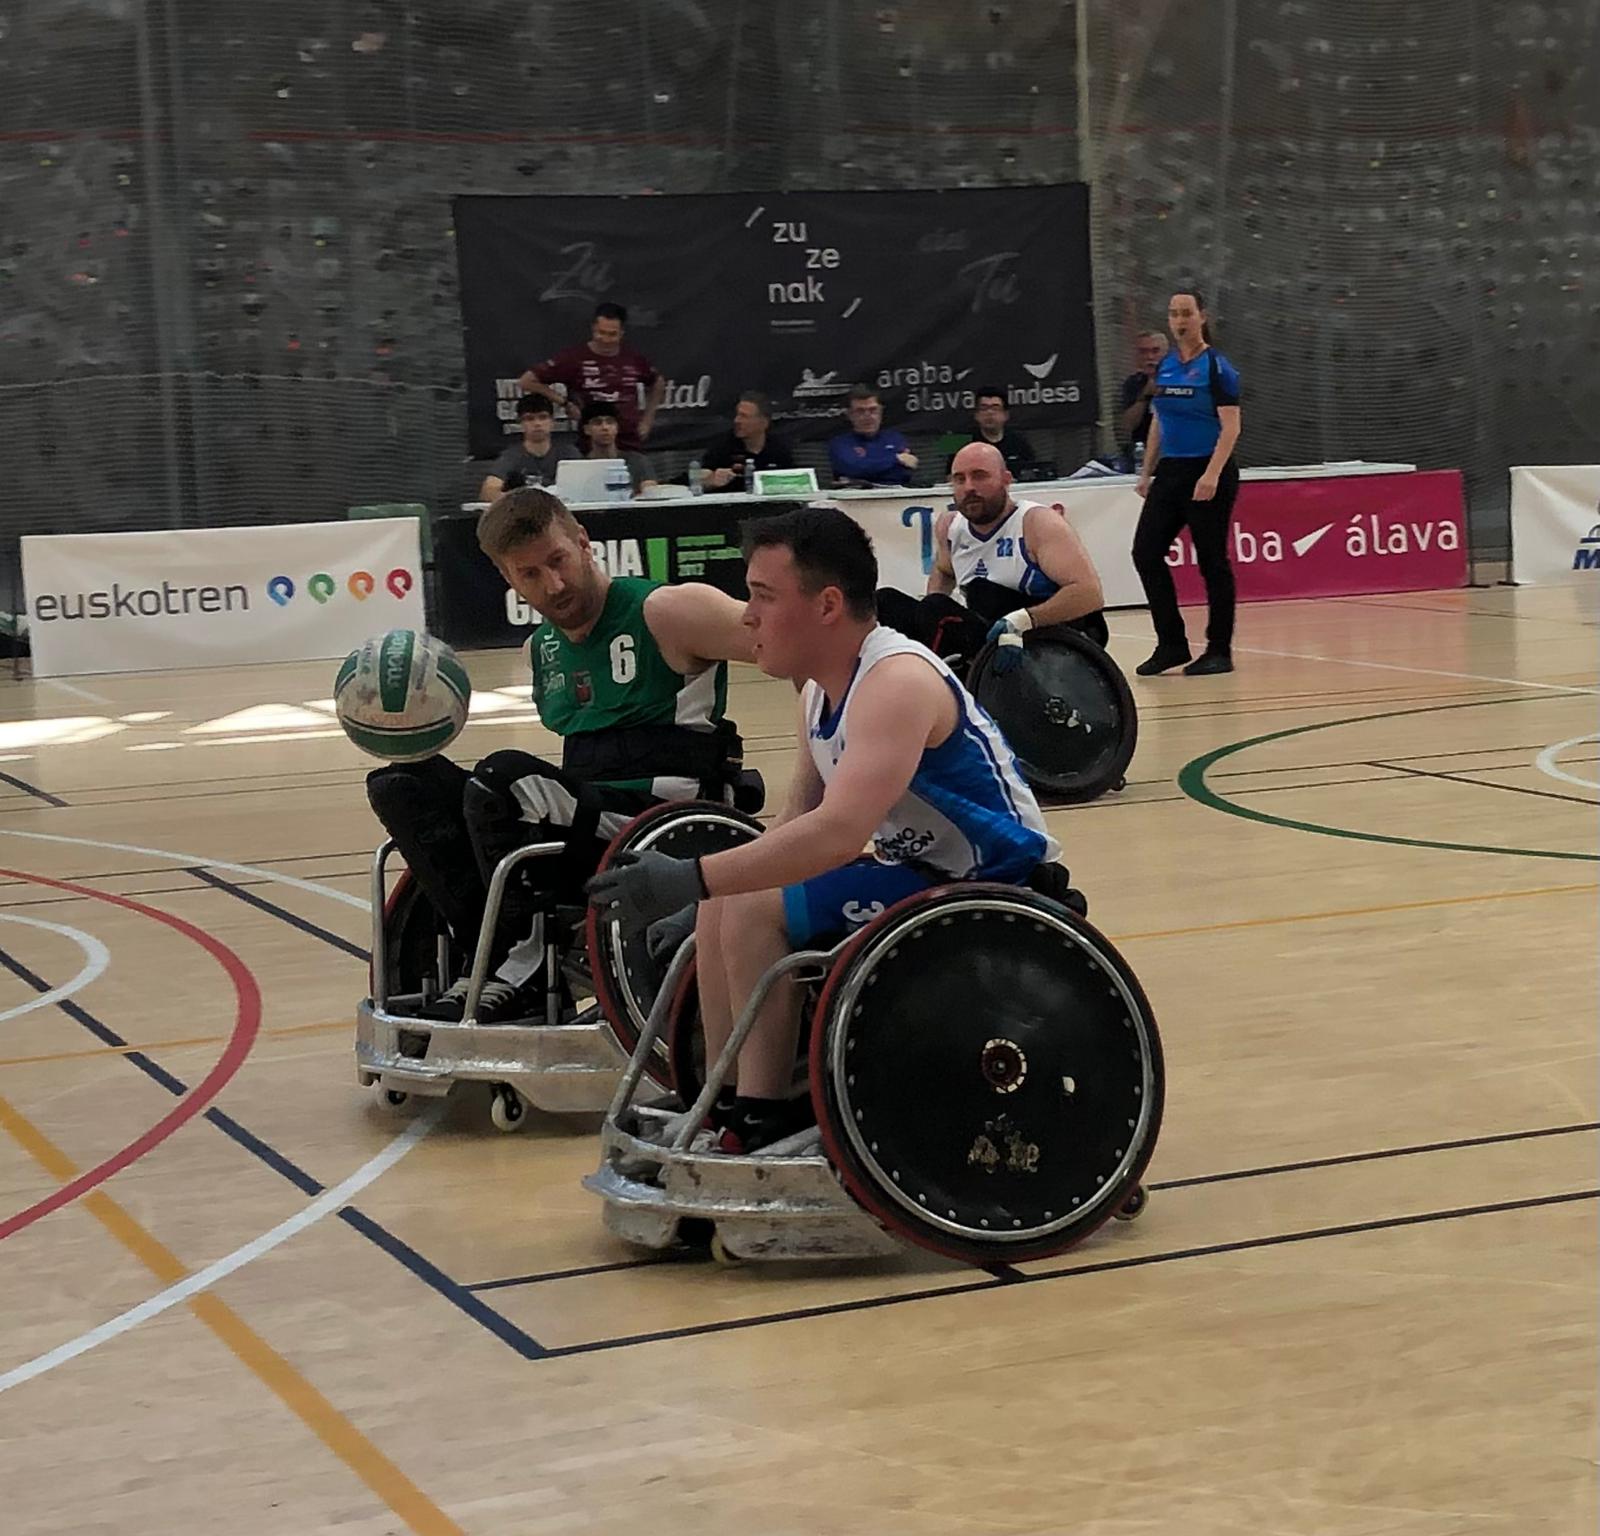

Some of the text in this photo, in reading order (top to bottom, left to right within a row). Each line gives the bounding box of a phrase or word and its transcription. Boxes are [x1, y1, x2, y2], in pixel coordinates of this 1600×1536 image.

[773, 222, 807, 243] zu
[805, 248, 841, 269] ze
[768, 275, 825, 303] nak
[877, 361, 953, 389] araba
[906, 386, 976, 412] álava
[1007, 381, 1080, 406] indesa
[996, 537, 1014, 557] 22
[1164, 514, 1459, 567] aba álava
[35, 581, 249, 622] euskotren
[609, 634, 636, 684] 6
[842, 900, 885, 931] 3
